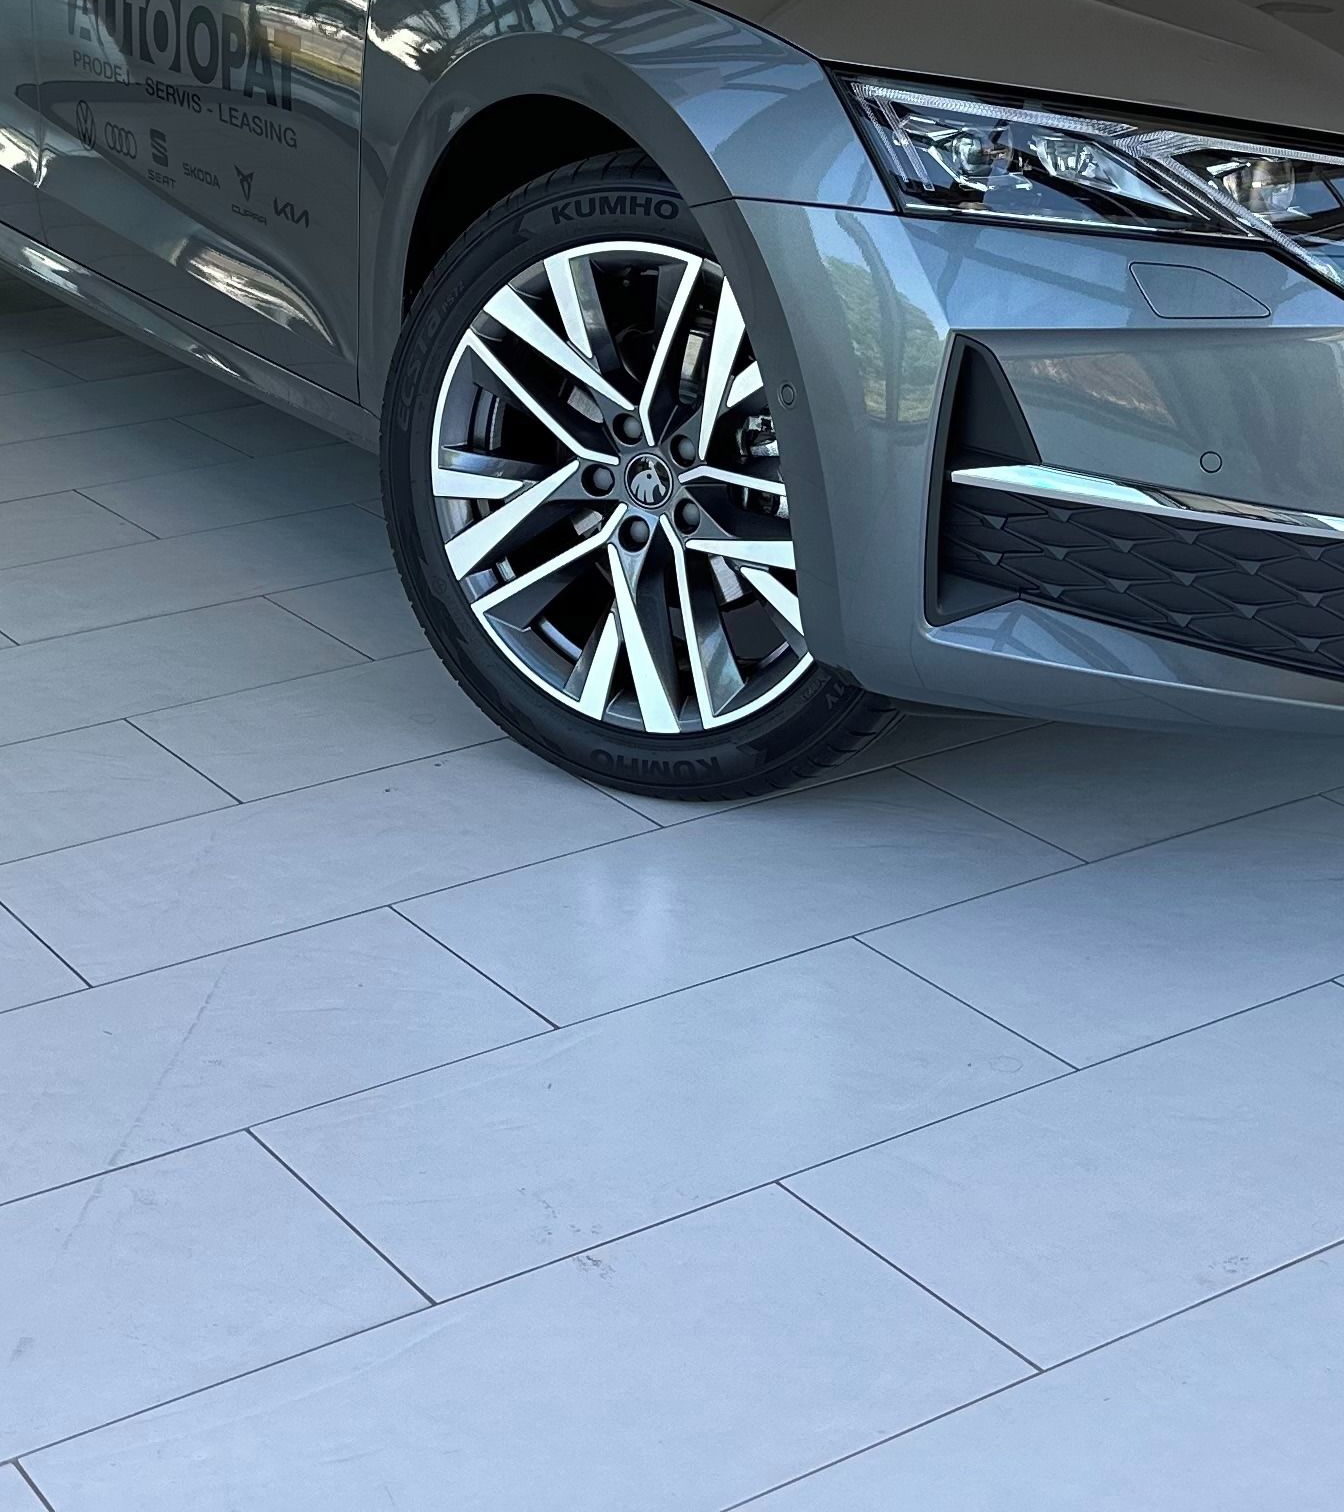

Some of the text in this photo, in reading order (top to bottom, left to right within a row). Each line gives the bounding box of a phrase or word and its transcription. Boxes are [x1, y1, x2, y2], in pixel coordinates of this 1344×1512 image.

[73, 50, 130, 87] PRODEJ
[146, 78, 201, 113] SERVIS
[219, 103, 298, 149] LEASING
[147, 169, 176, 189] SEAT
[552, 195, 679, 225] KUMHO
[589, 747, 724, 779] KUMHO
